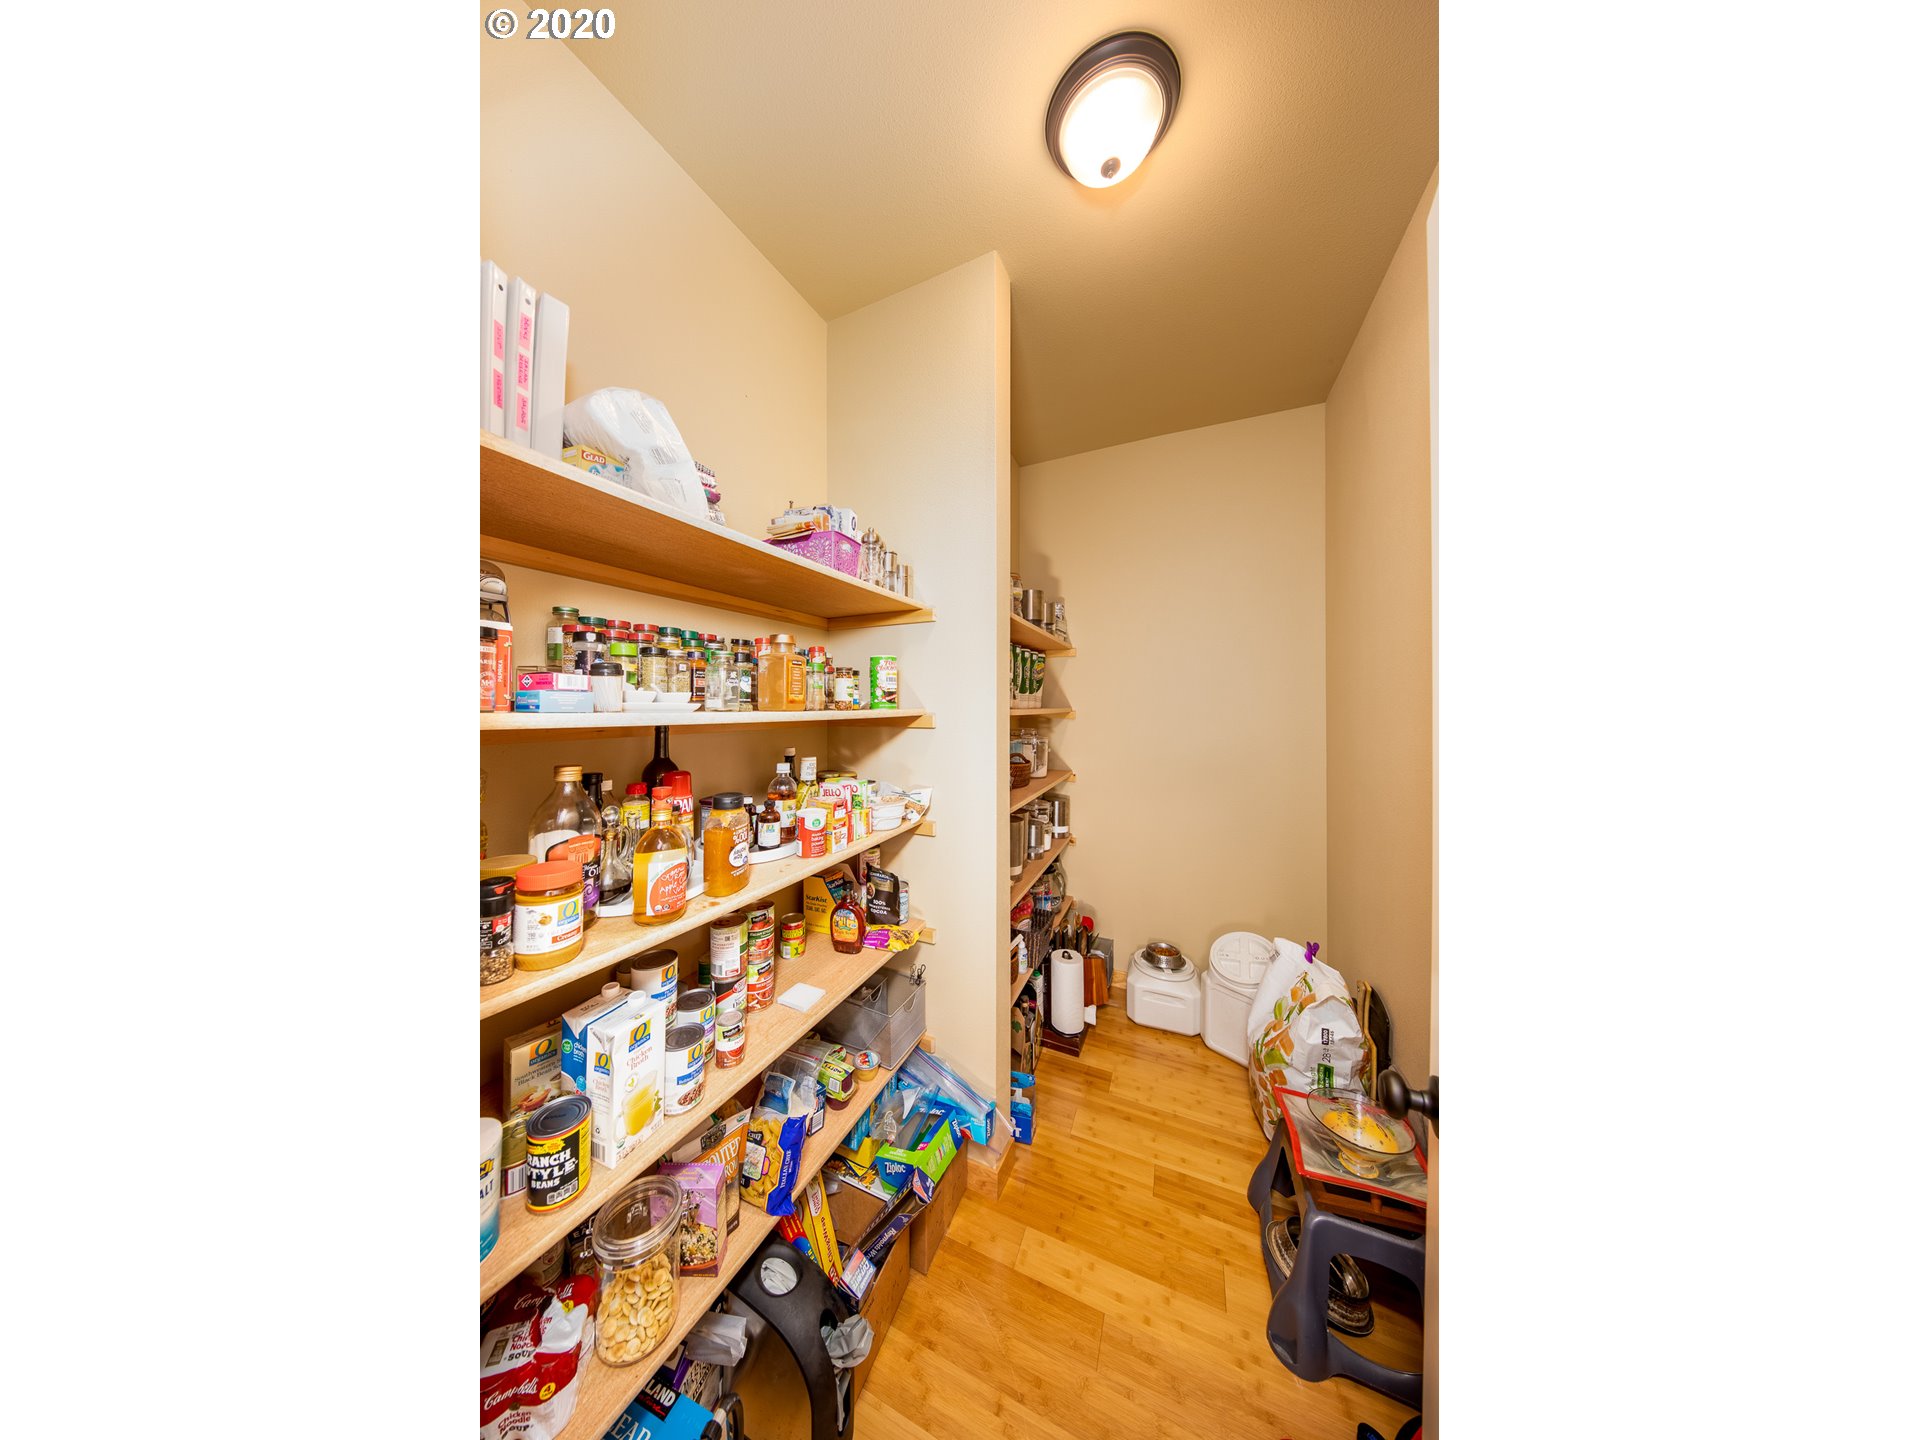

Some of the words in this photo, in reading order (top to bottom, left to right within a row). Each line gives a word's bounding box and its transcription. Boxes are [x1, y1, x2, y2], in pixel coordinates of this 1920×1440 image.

[583, 451, 605, 464] GLAD
[805, 894, 828, 904] StarKist
[873, 899, 887, 907] 100%
[870, 907, 888, 916] COCOA
[527, 1148, 571, 1168] RANCH
[884, 1162, 907, 1176] Ziploc
[480, 1179, 493, 1199] ALT
[531, 1177, 560, 1190] BEANS
[874, 1227, 897, 1252] Reynolds
[645, 1379, 676, 1407] LAND
